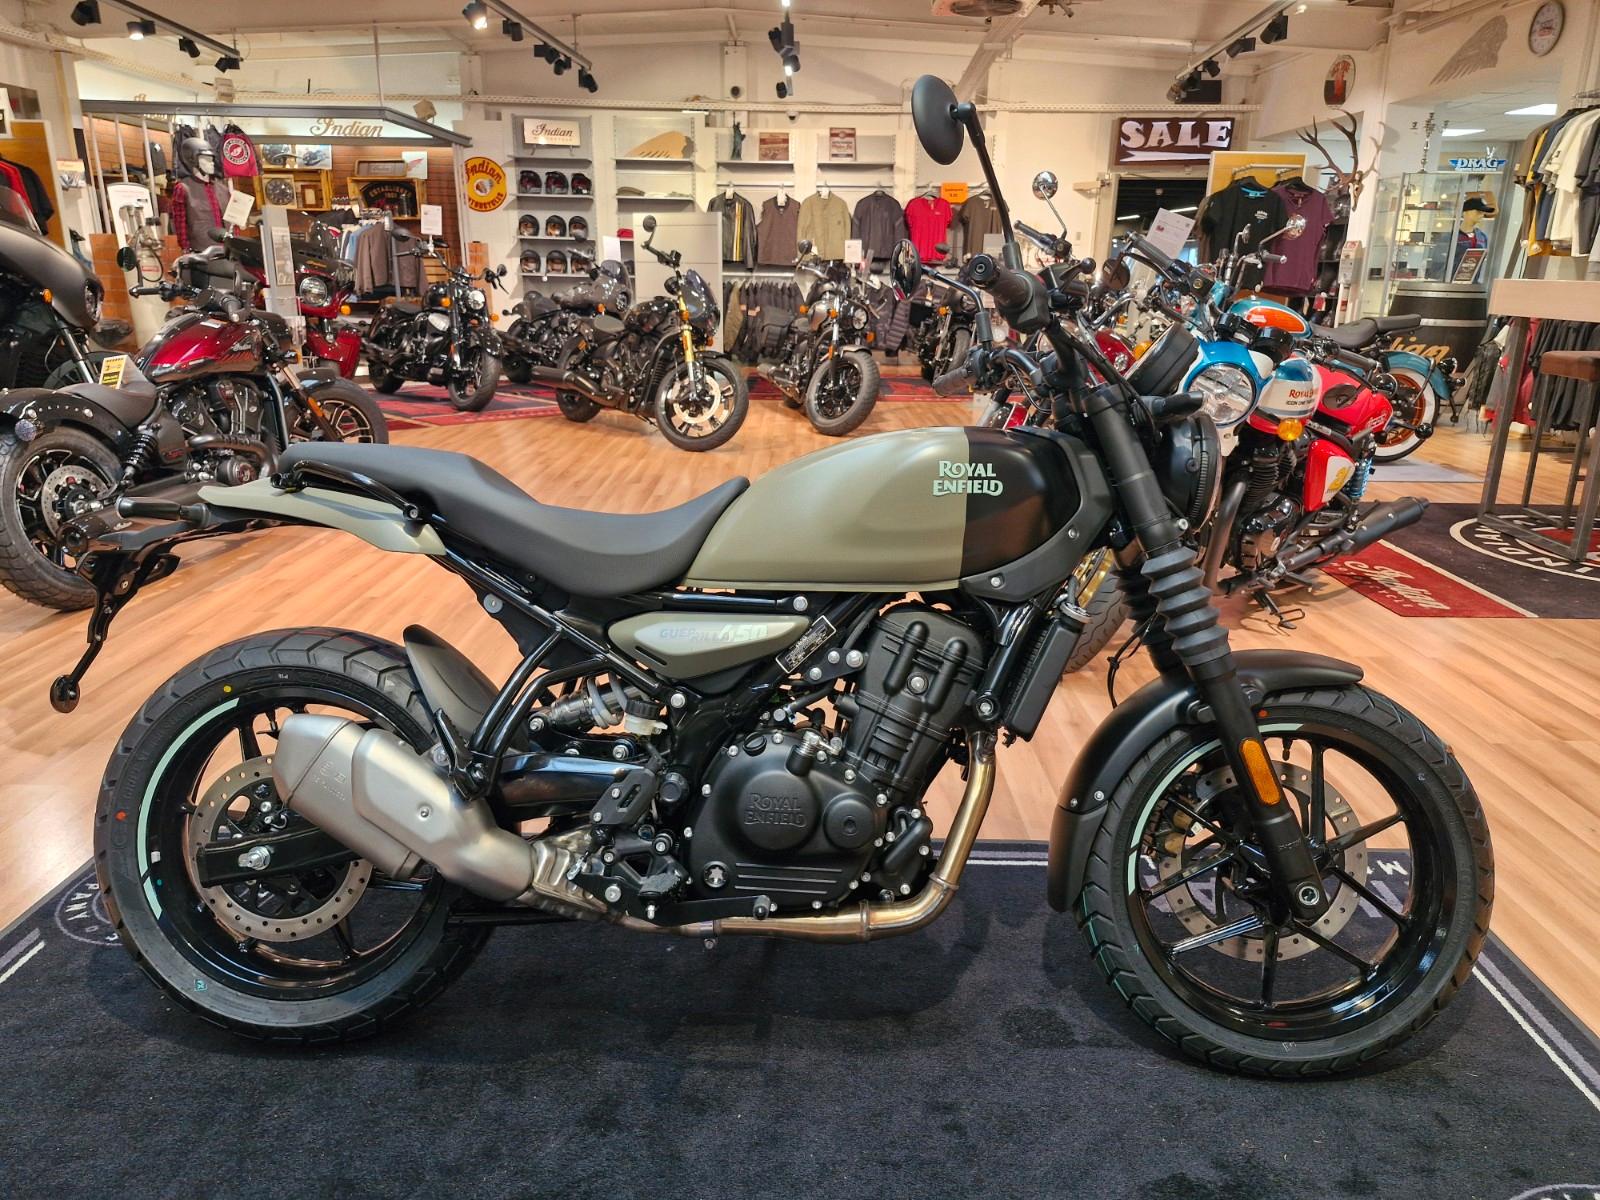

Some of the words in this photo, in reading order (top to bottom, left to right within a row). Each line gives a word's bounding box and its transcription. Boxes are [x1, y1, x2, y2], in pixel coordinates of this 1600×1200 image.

[309, 117, 384, 137] Indian
[531, 122, 574, 137] Indian
[1120, 120, 1232, 149] SALE
[1456, 157, 1498, 168] DRAG
[939, 461, 997, 479] ROYAL
[932, 479, 1004, 497] ENFIELD
[746, 792, 801, 811] ROYAL
[743, 810, 808, 828] ENFIELD
